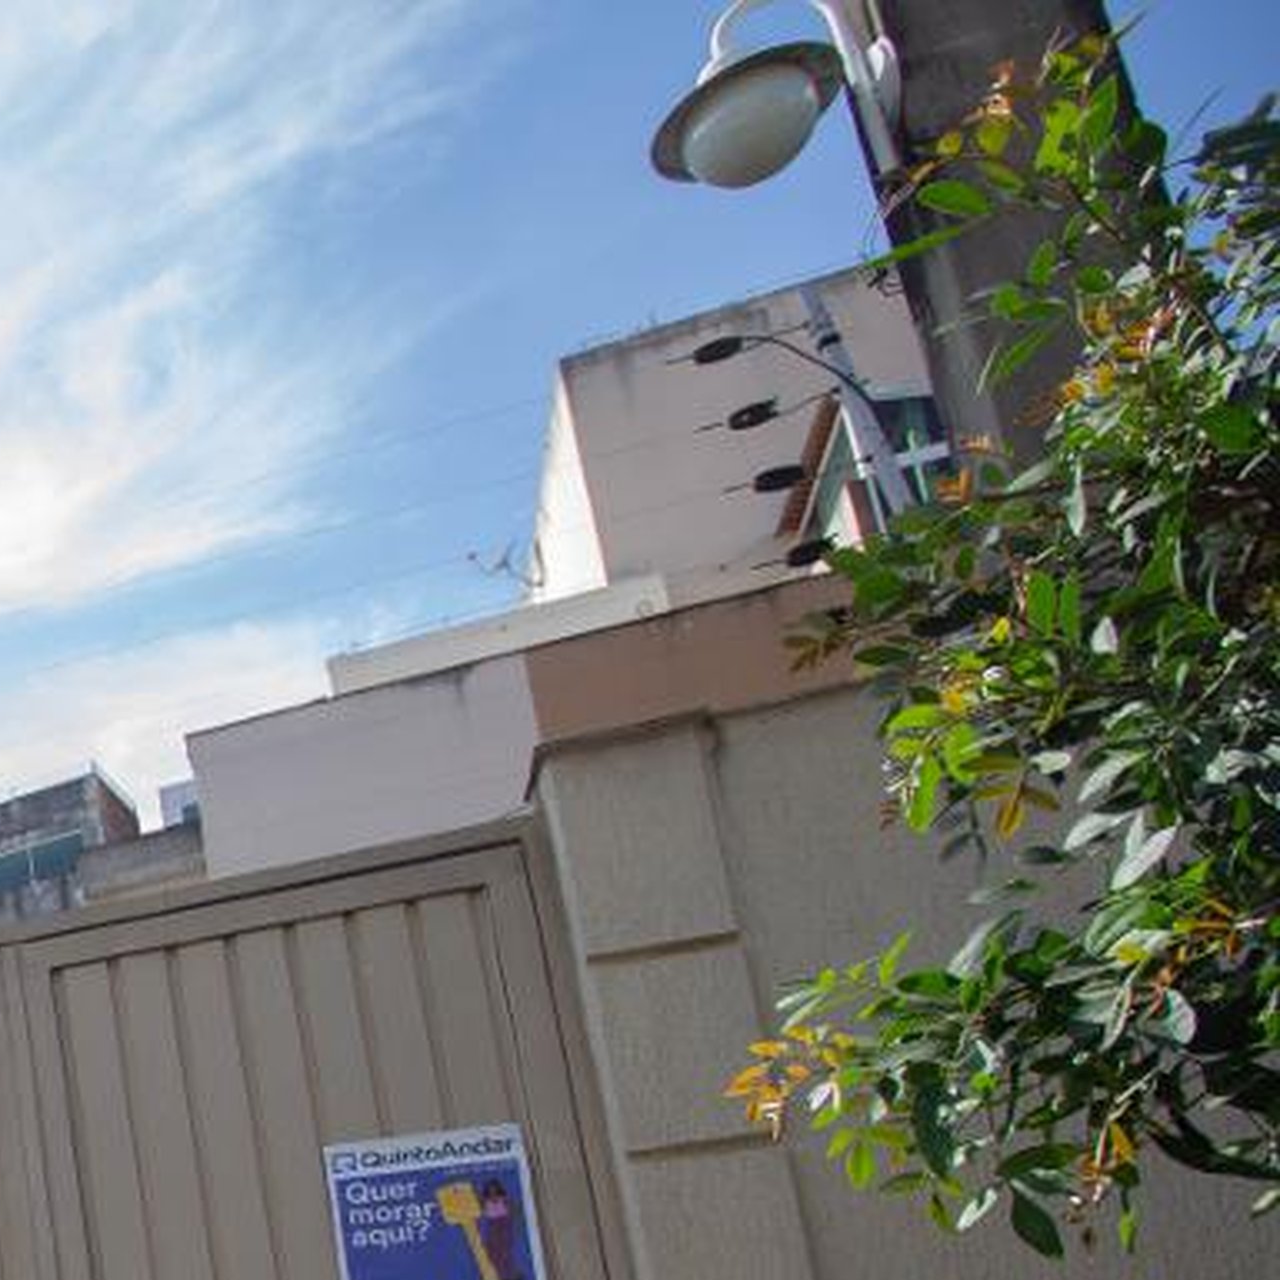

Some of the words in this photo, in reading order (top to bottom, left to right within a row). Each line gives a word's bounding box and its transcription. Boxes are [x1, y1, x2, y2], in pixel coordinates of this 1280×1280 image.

[361, 1137, 513, 1167] QuintoAndar
[345, 1181, 418, 1205] Quer
[349, 1202, 437, 1225] morar
[352, 1219, 431, 1249] aqui?
